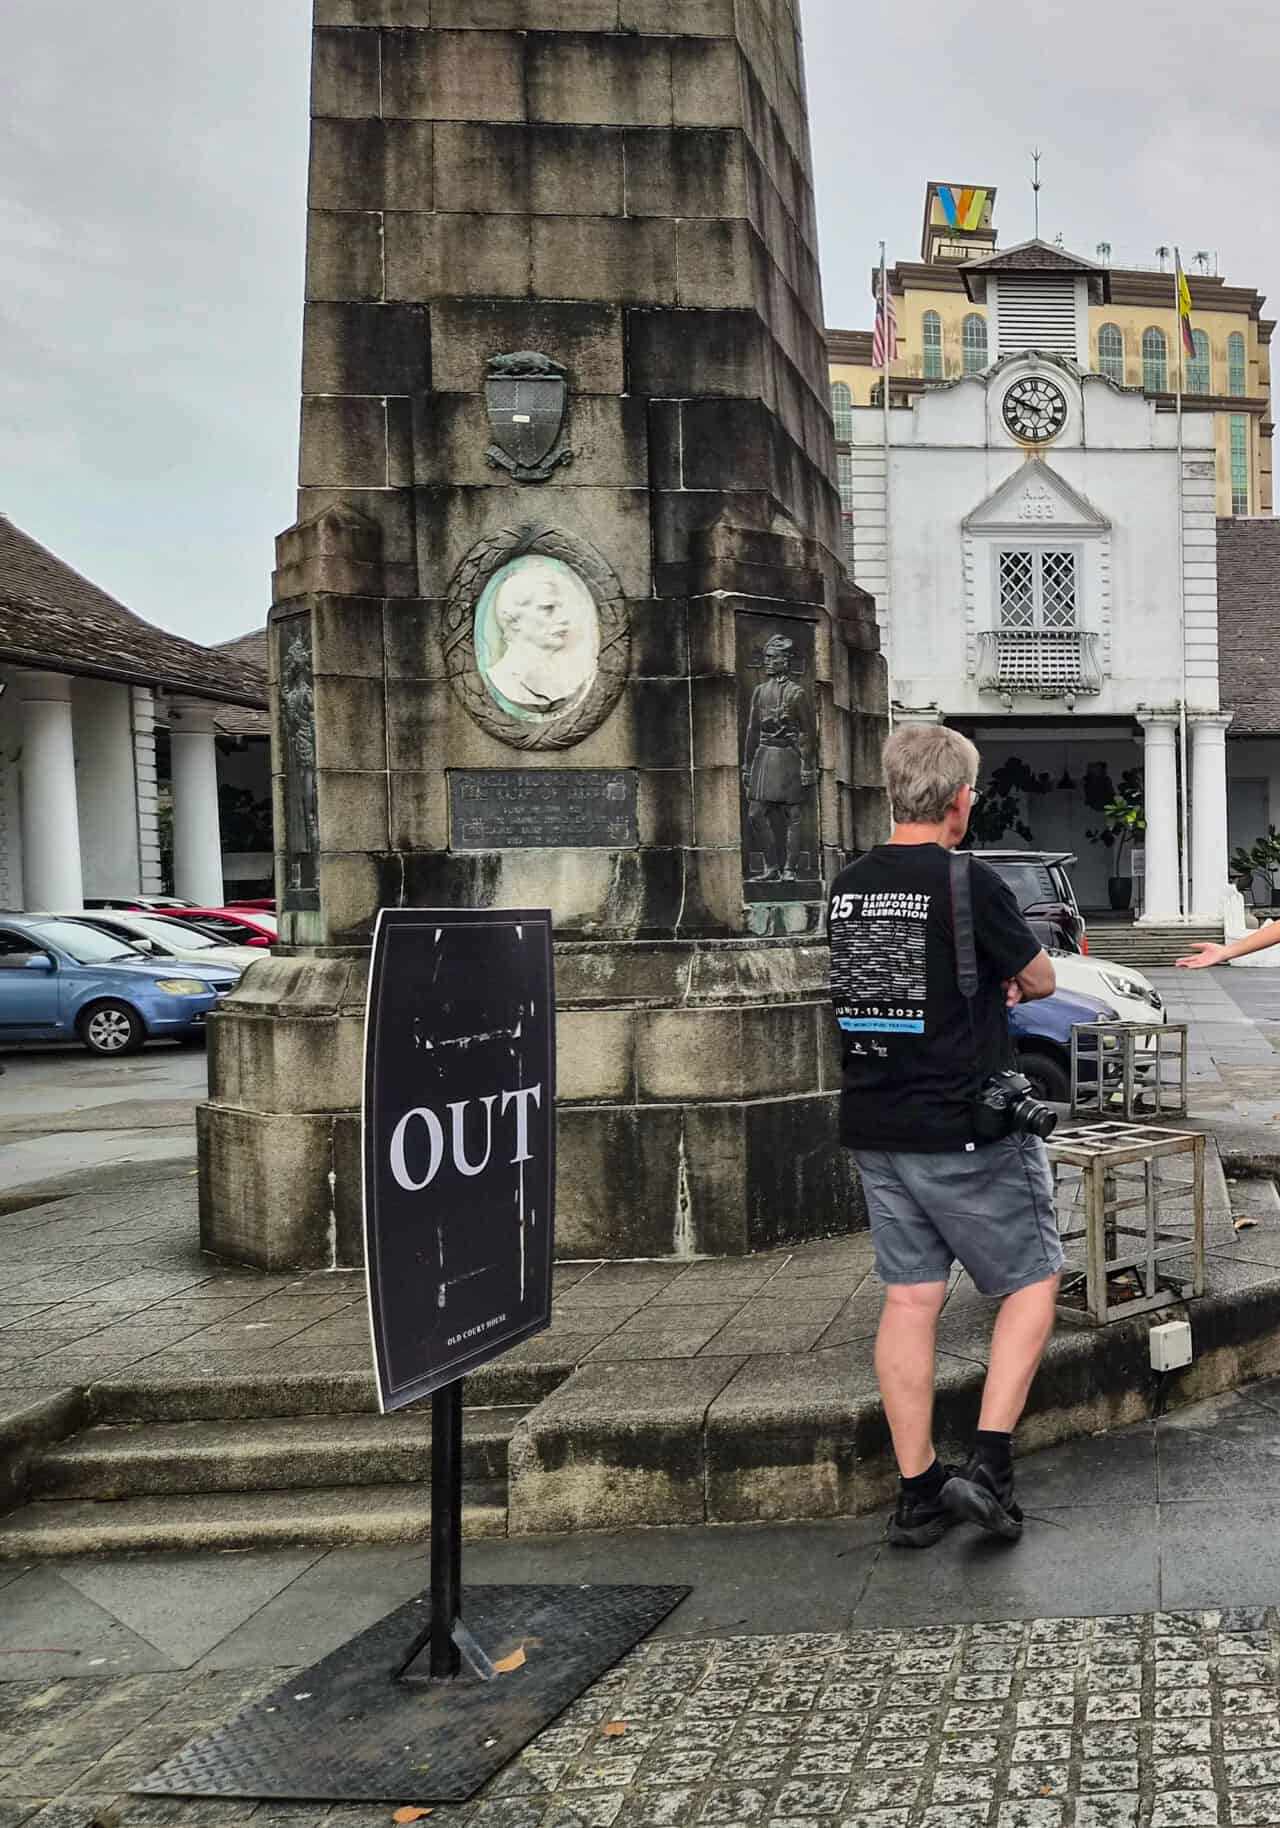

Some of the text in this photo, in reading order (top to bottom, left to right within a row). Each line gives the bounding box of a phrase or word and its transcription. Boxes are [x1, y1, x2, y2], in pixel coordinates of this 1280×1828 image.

[864, 893, 931, 903] LEGENDARY
[862, 900, 930, 911] RAINFOREST
[861, 909, 928, 919] CELEBRATION
[390, 1082, 542, 1191] OUT
[447, 1334, 462, 1346] OLD
[462, 1322, 486, 1339] COURT
